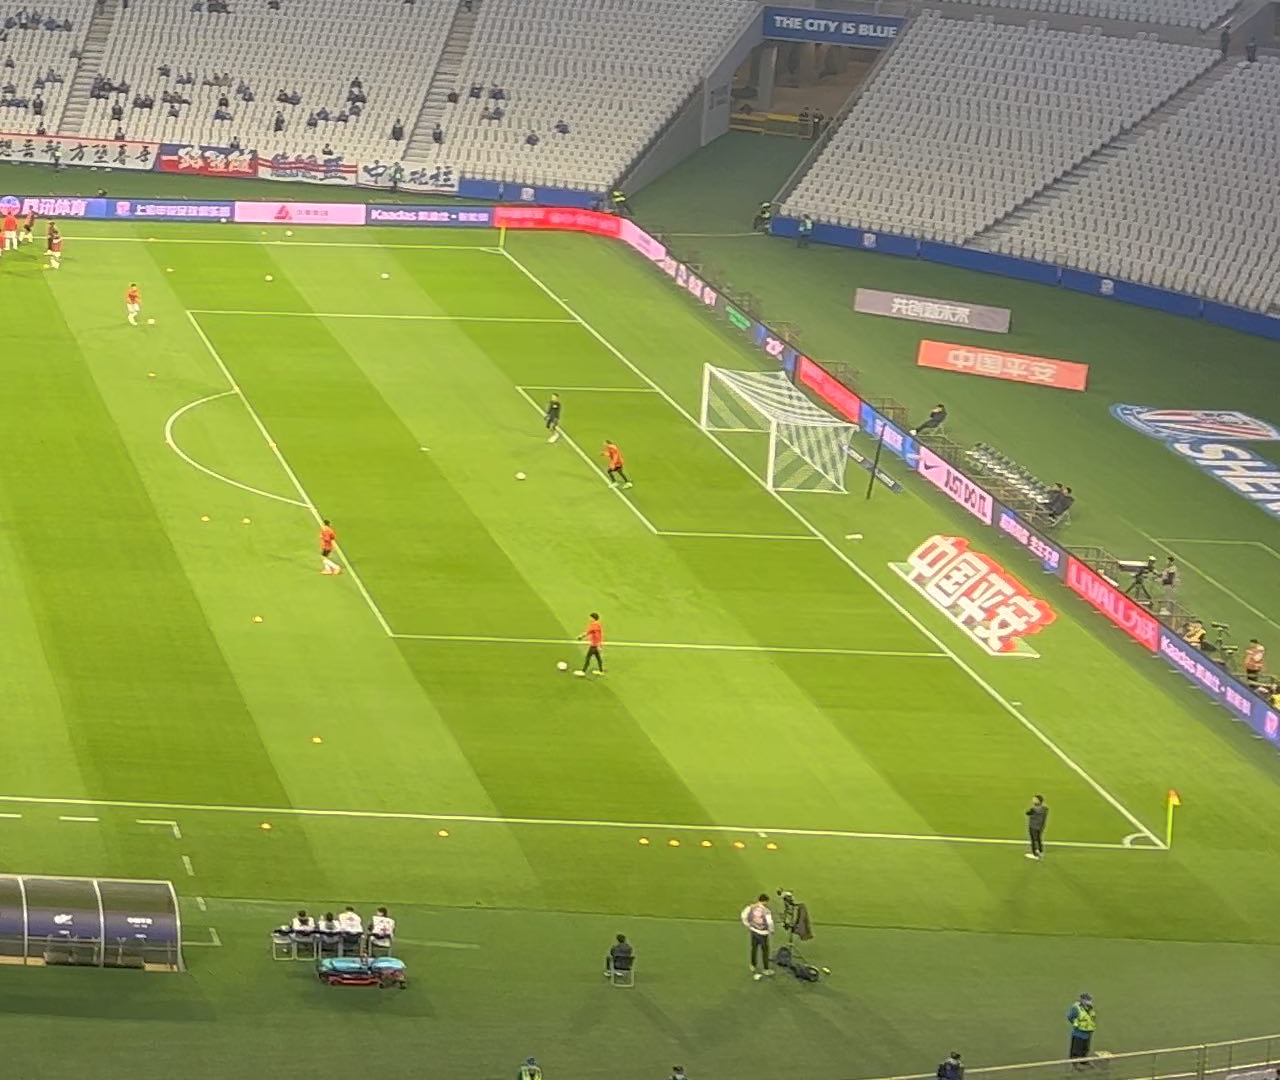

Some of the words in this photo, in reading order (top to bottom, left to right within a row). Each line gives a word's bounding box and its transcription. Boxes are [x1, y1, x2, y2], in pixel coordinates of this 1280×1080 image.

[774, 15, 802, 29] THE
[804, 17, 838, 32] CITY
[842, 21, 856, 35] IS
[858, 23, 897, 38] BLUE
[947, 350, 1057, 383] 中国平安
[907, 534, 1043, 652] 中国平安
